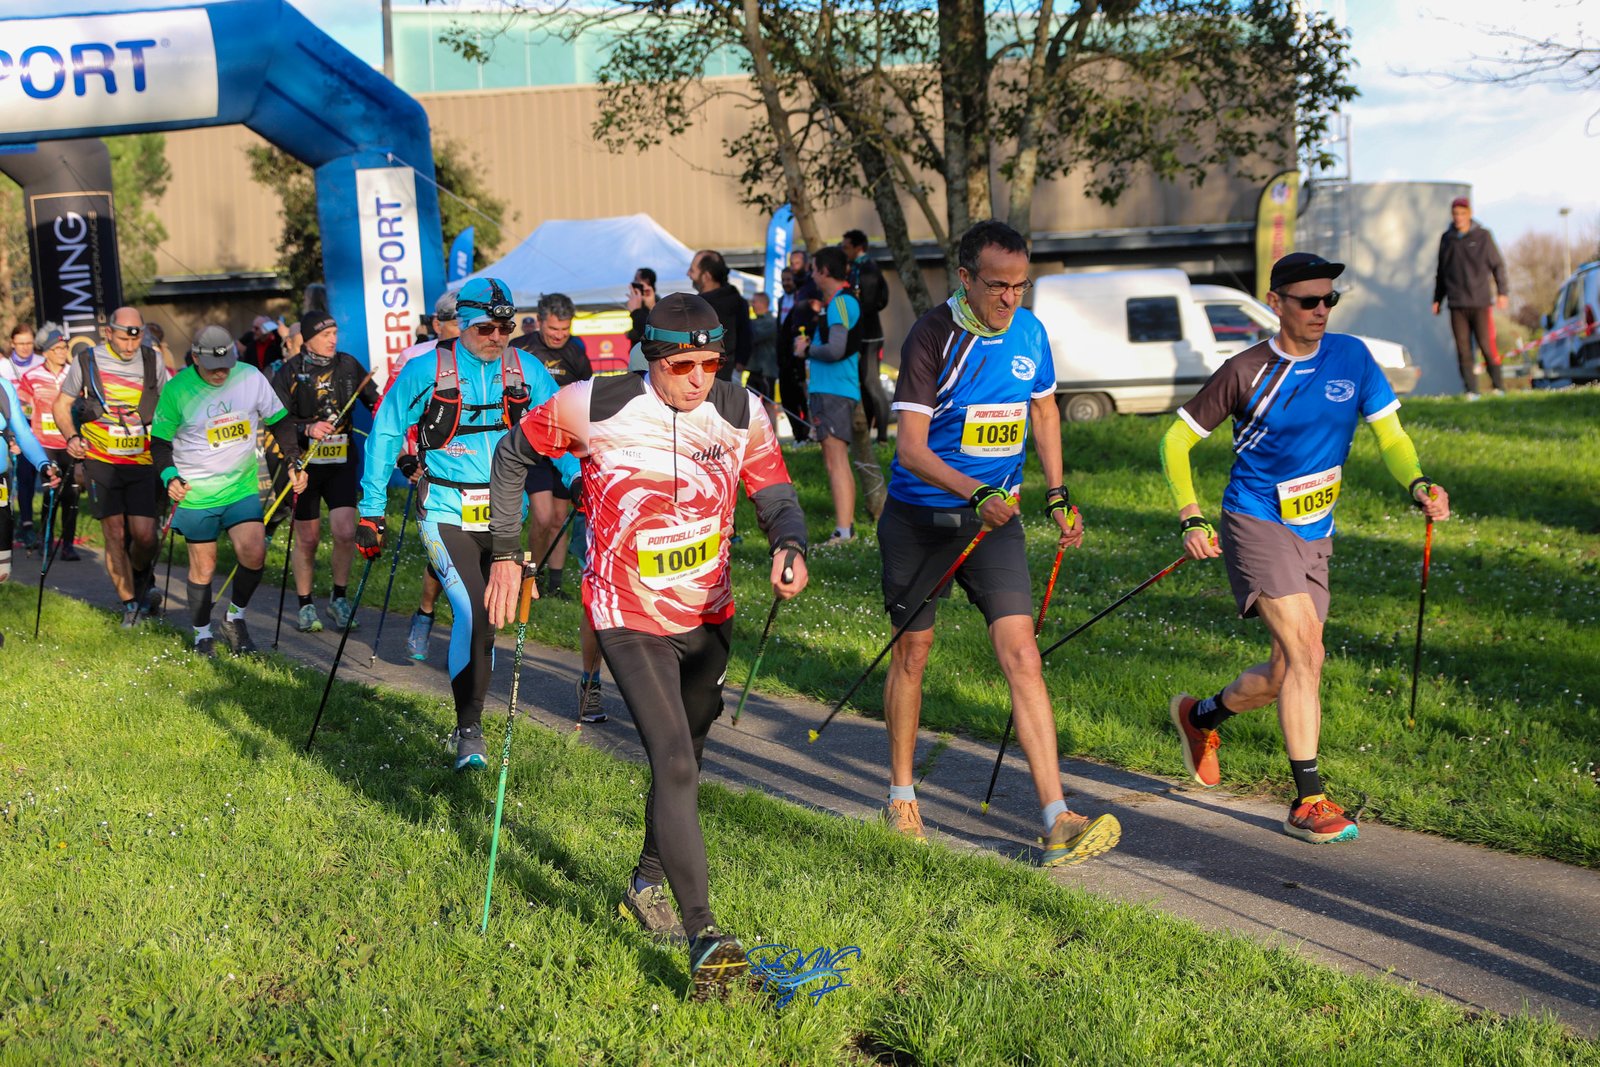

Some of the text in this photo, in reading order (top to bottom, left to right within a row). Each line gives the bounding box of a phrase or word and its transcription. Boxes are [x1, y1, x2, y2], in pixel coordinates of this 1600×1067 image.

[54, 211, 96, 340] TIMING
[214, 423, 245, 440] 1028
[976, 423, 1018, 444] 1036
[115, 437, 140, 448] 1032
[317, 446, 342, 457] 1037
[1293, 487, 1333, 515] 1035
[653, 541, 707, 574] 1001
